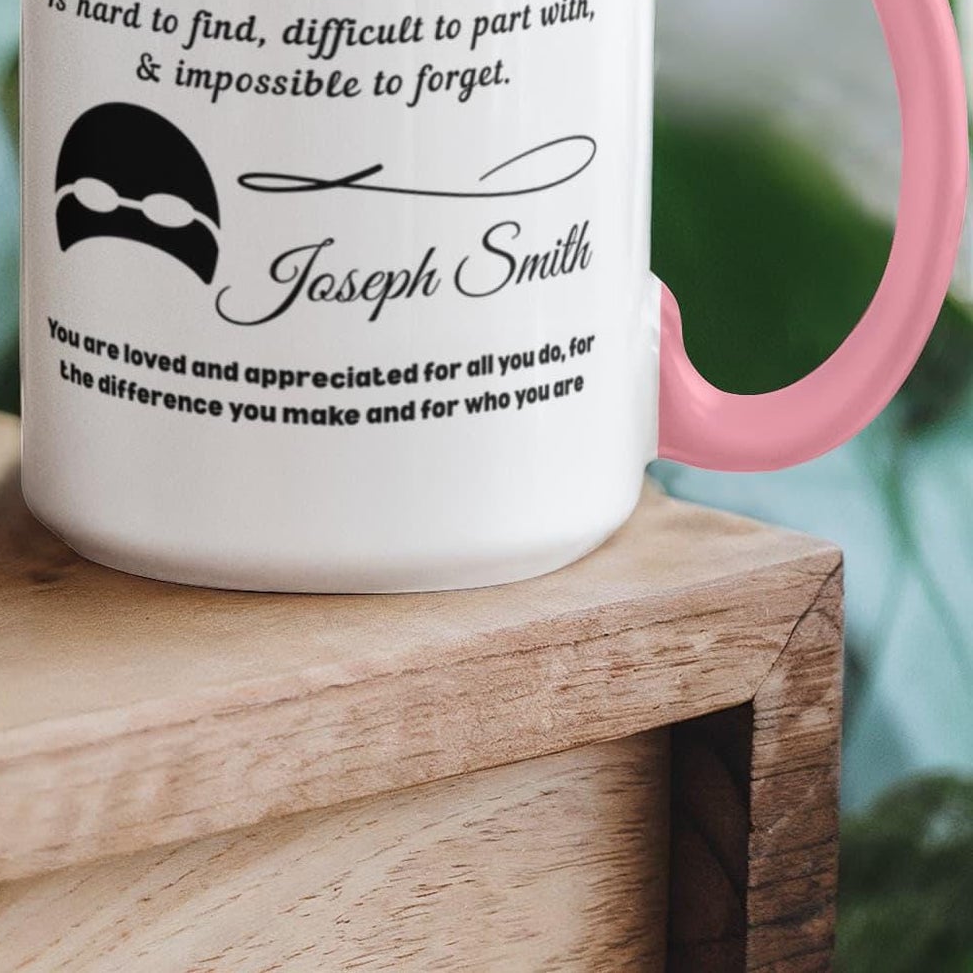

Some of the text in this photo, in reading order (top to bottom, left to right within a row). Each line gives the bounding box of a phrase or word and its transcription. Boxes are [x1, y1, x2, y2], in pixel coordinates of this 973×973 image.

[151, 7, 179, 35] to
[181, 9, 266, 51] find,
[281, 15, 423, 61] difficult
[434, 15, 462, 41] to
[470, 5, 531, 51] part
[135, 52, 510, 108] & impossible to forget.
[214, 220, 593, 327] Joseph Smith
[46, 315, 595, 391] You are loved and appreciated for all you do, for
[59, 358, 584, 427] the difference you make and for who you are
